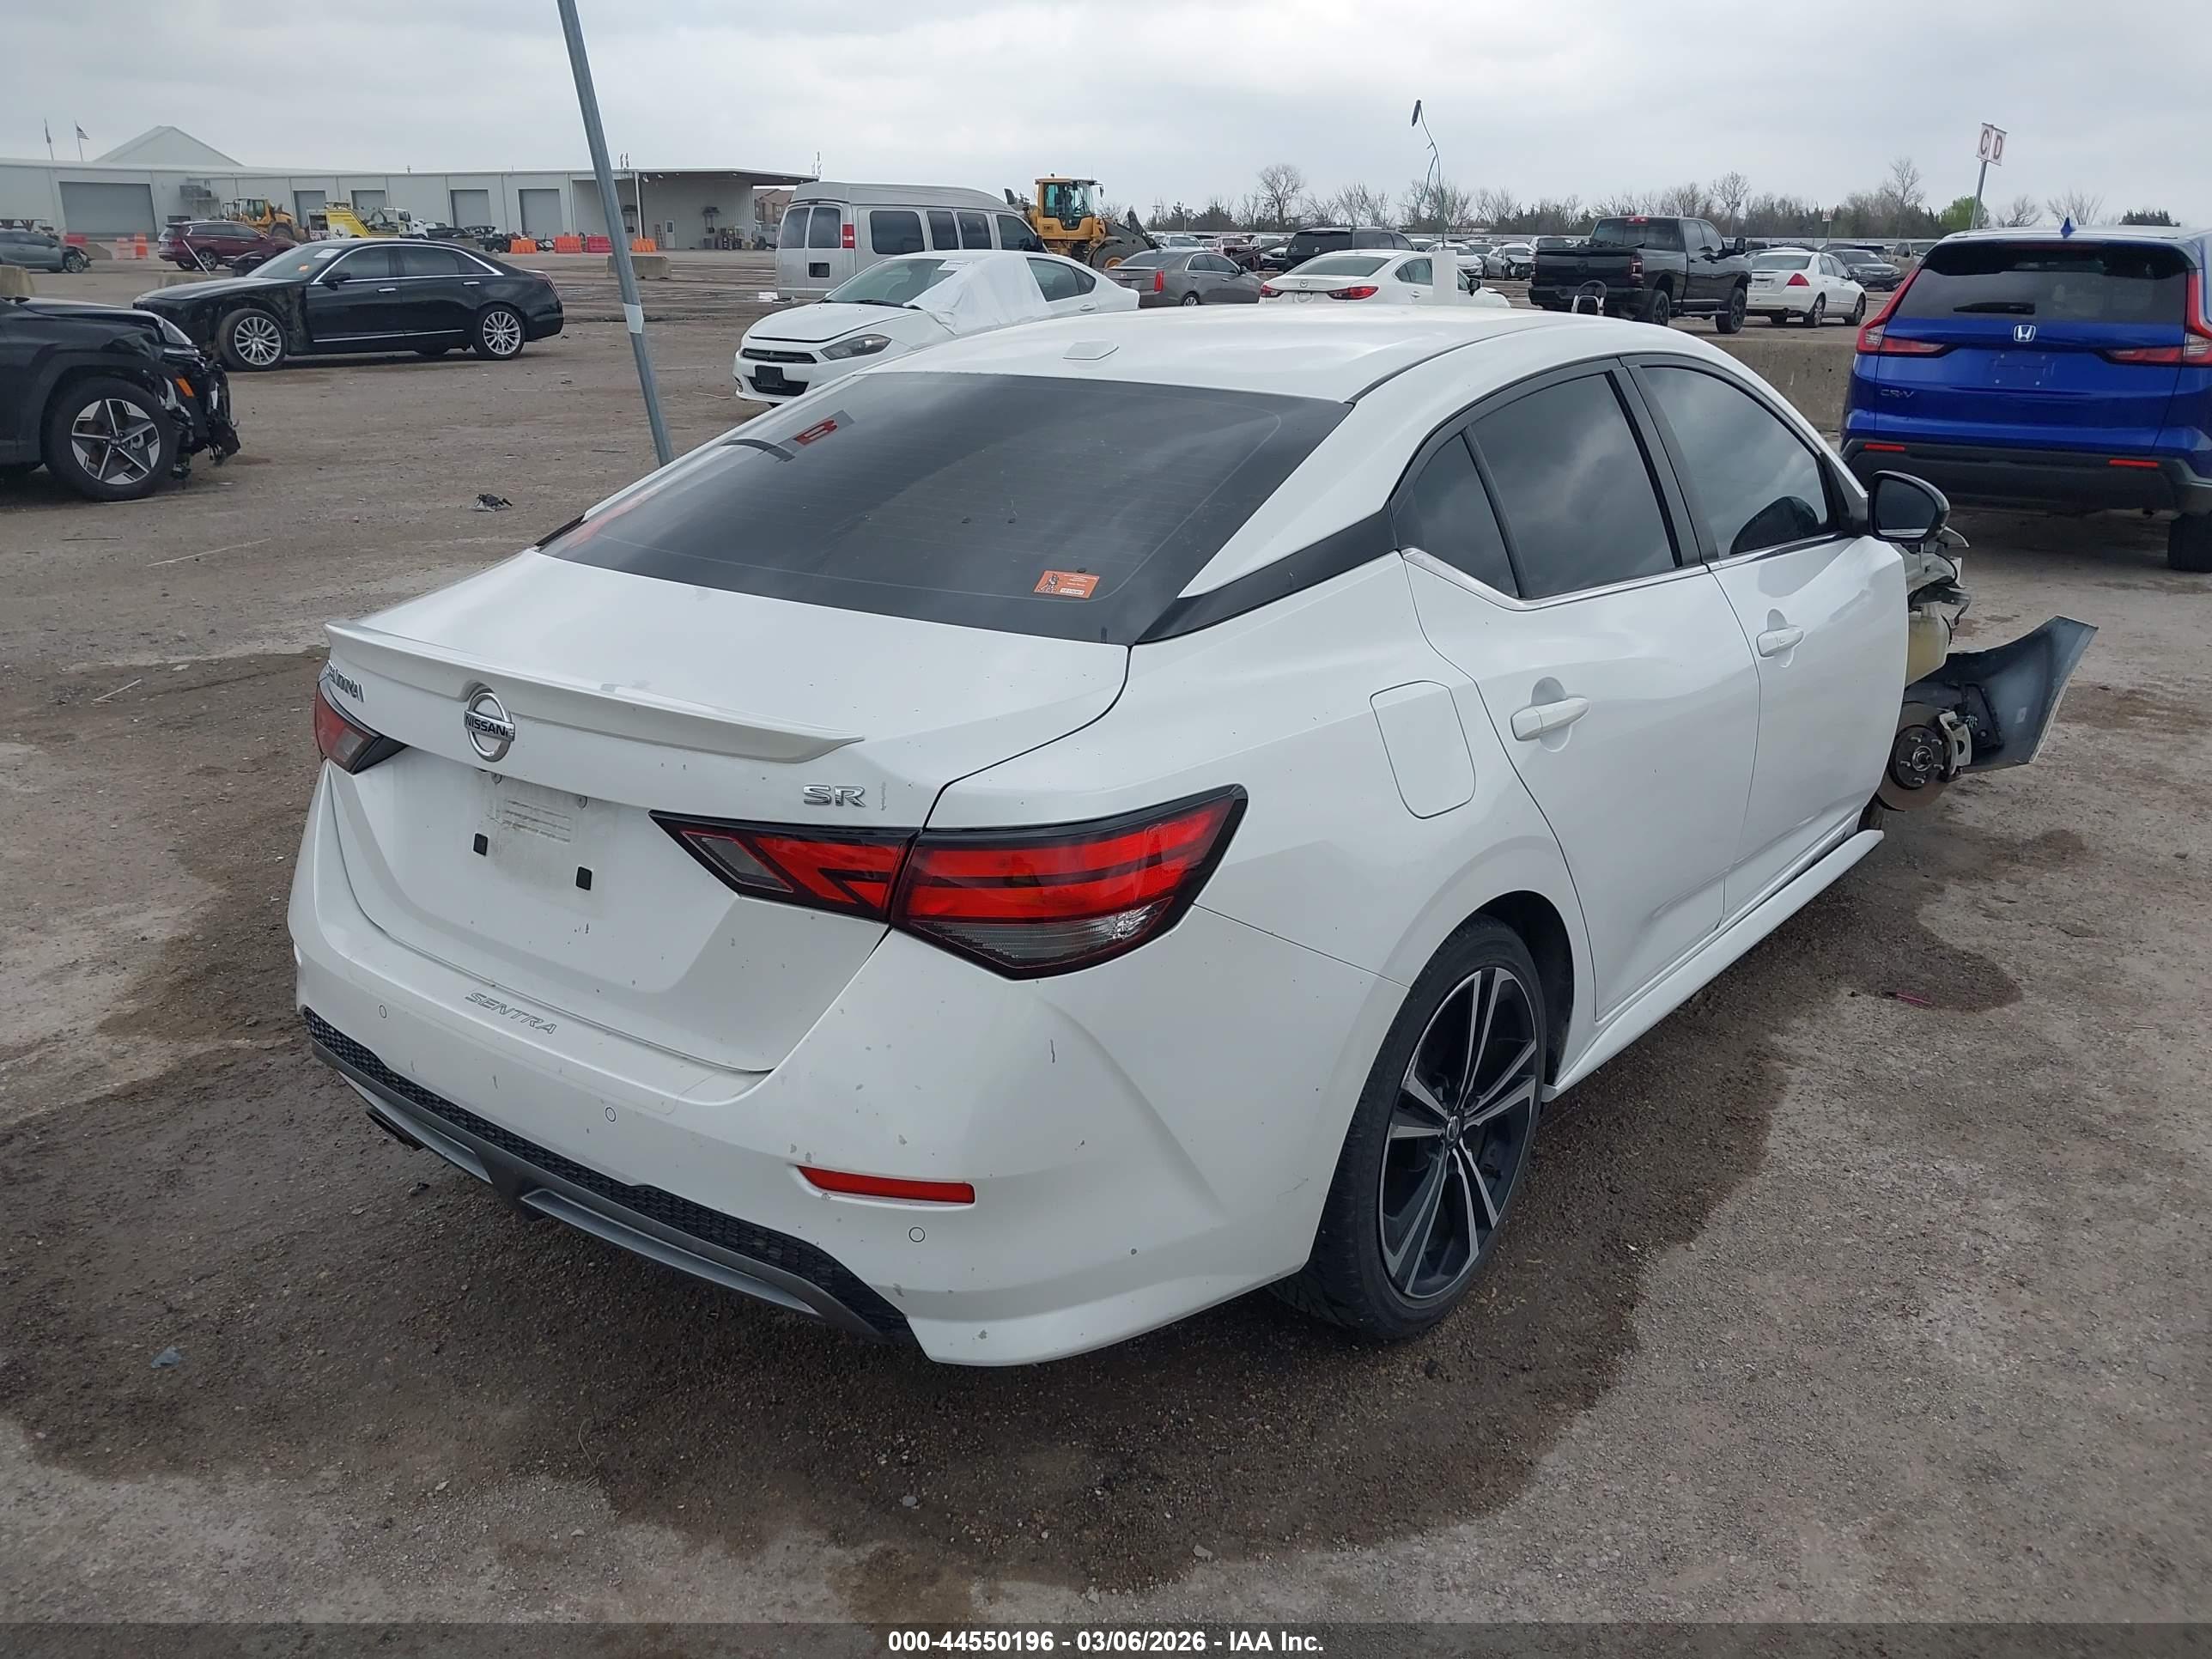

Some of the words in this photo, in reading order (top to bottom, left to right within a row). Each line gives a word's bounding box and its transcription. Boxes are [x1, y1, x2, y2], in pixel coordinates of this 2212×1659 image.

[1980, 129, 1990, 155] C
[1993, 134, 2002, 160] D
[465, 714, 507, 737] NISSAN
[803, 784, 866, 808] SR
[465, 992, 557, 1035] SENTRA
